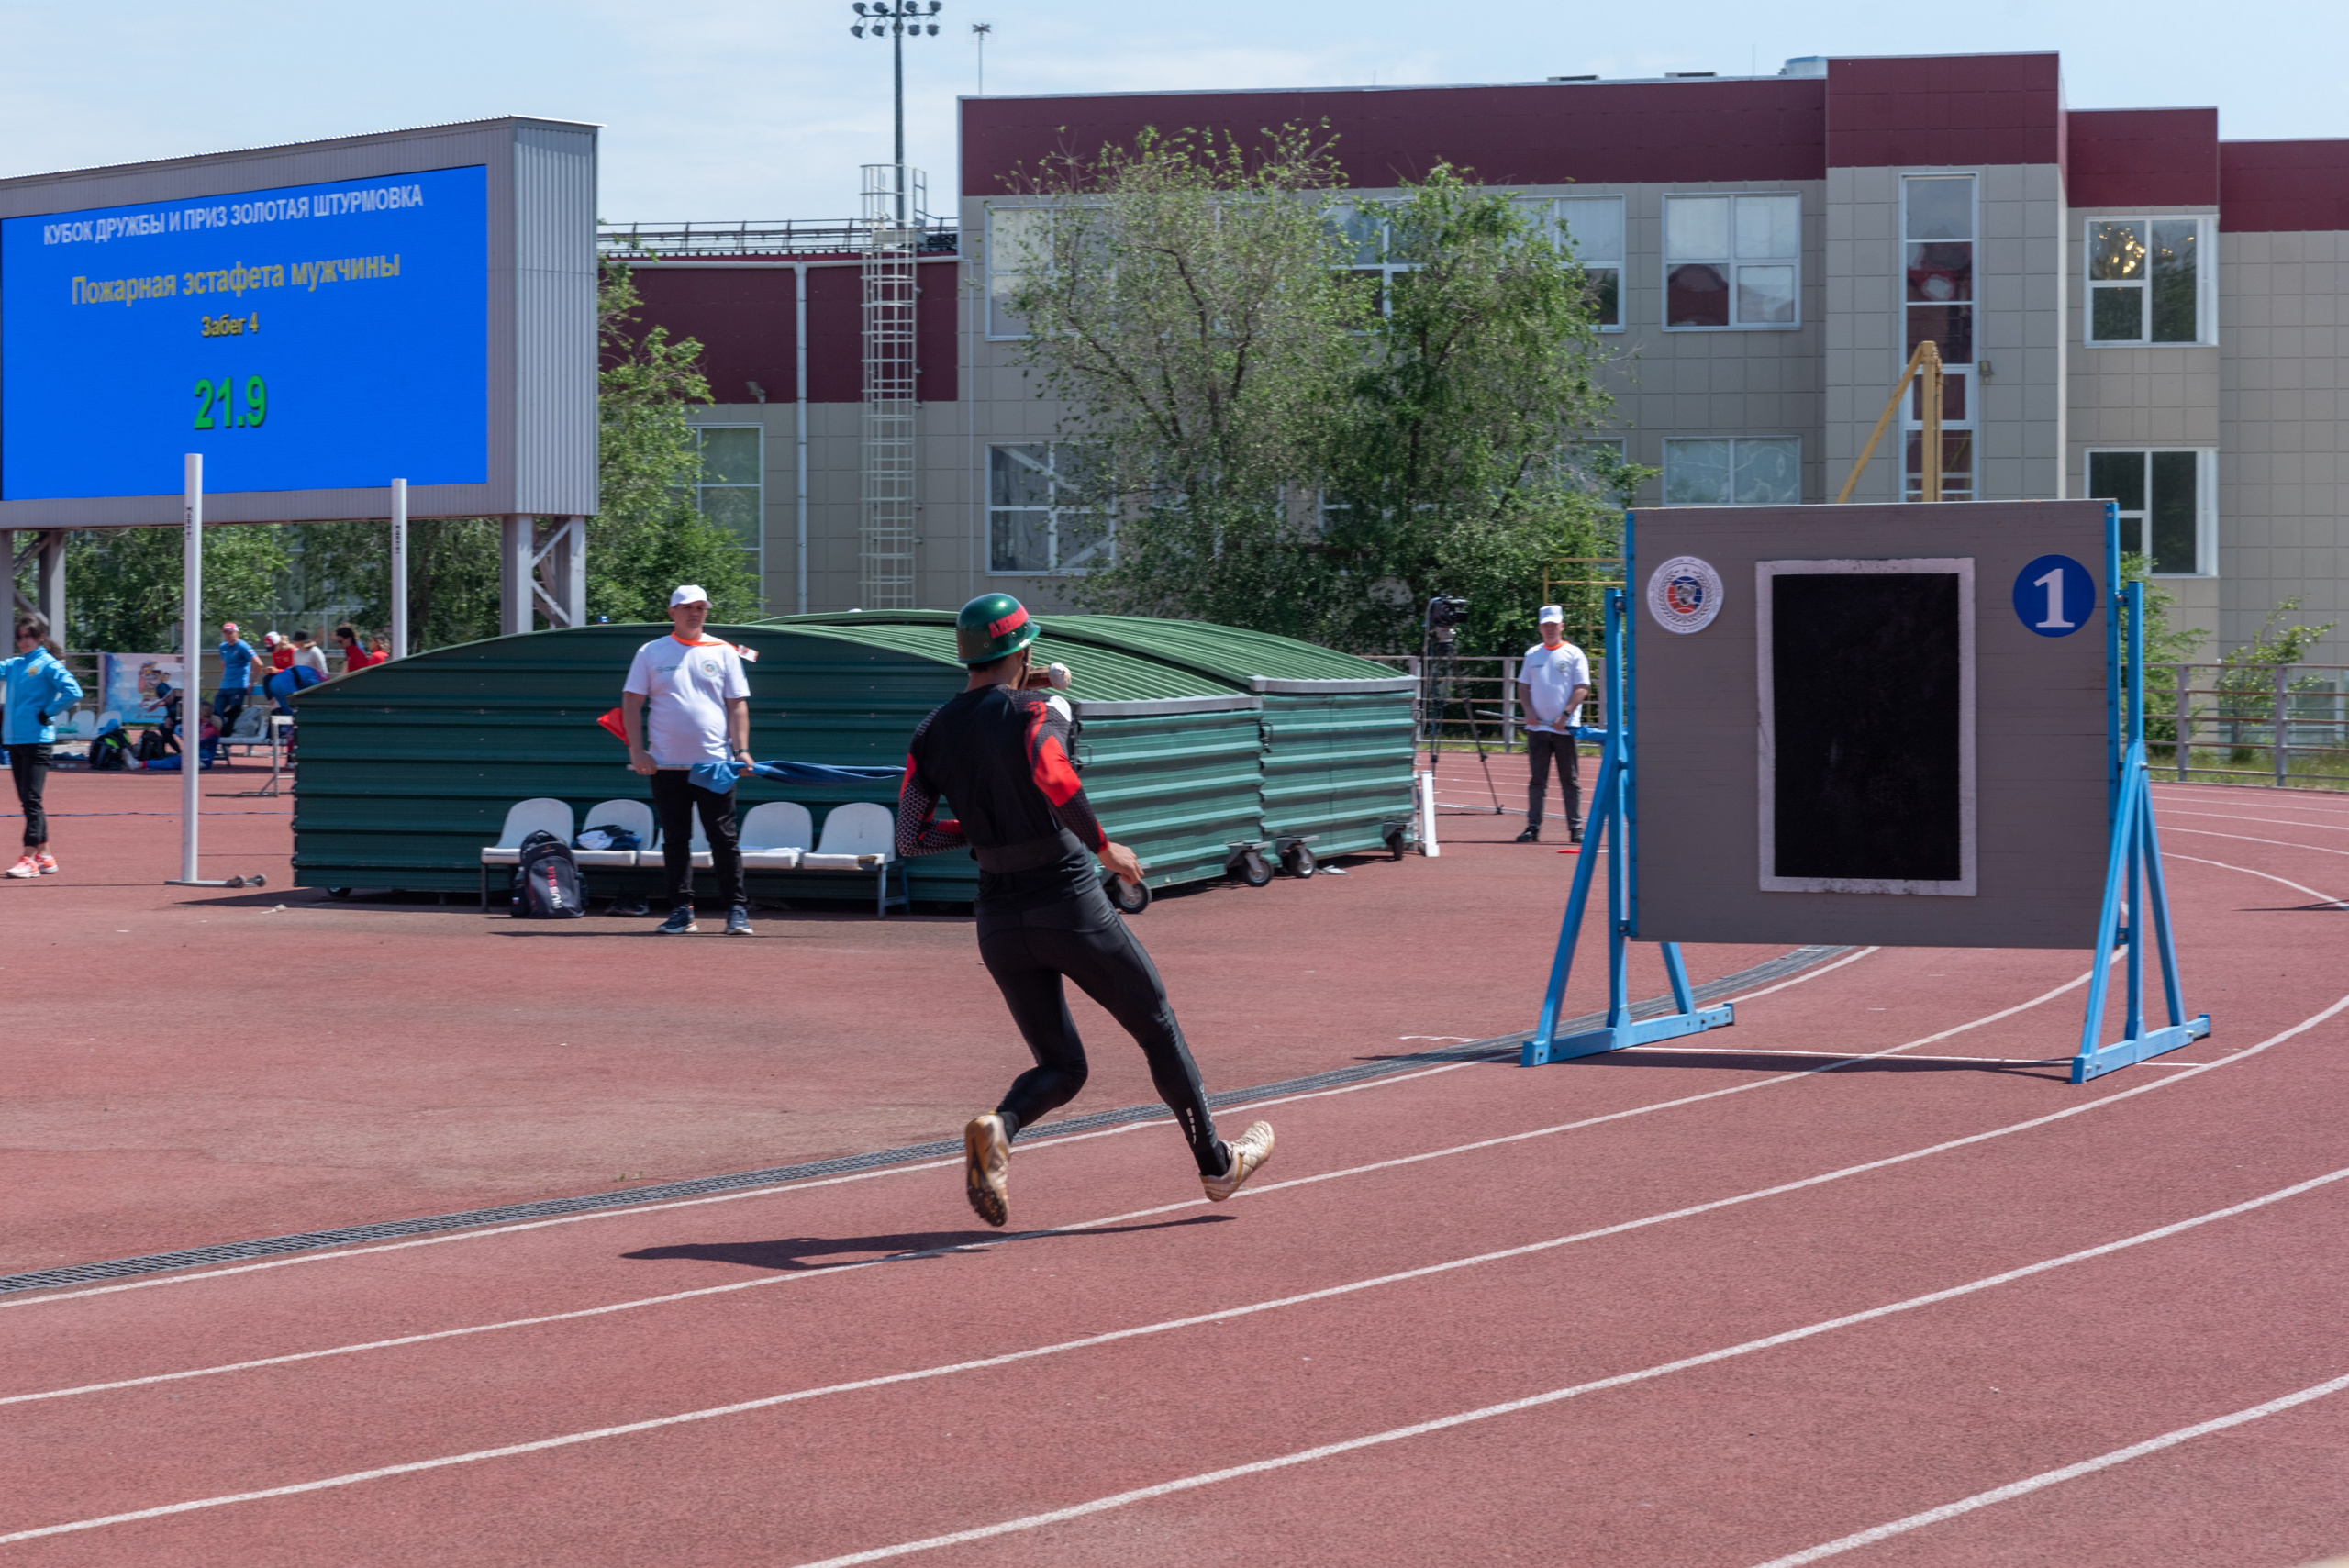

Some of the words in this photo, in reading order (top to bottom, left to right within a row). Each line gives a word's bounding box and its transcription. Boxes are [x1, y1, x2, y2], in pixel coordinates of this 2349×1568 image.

[44, 221, 93, 245] КУБОК
[95, 213, 165, 244] ДРУЖБЫ
[169, 212, 181, 231] И
[184, 206, 228, 230] ПРИЗ
[230, 197, 309, 226] ЗОЛОТАЯ
[314, 184, 423, 217] ШТУРМОВКА
[72, 274, 176, 306] Пожарная
[183, 261, 284, 297] эстафета
[291, 254, 400, 292] мужчины
[201, 314, 246, 337] Забег
[249, 311, 260, 333] 4
[194, 374, 267, 429] 21.9
[2033, 568, 2076, 628] 1
